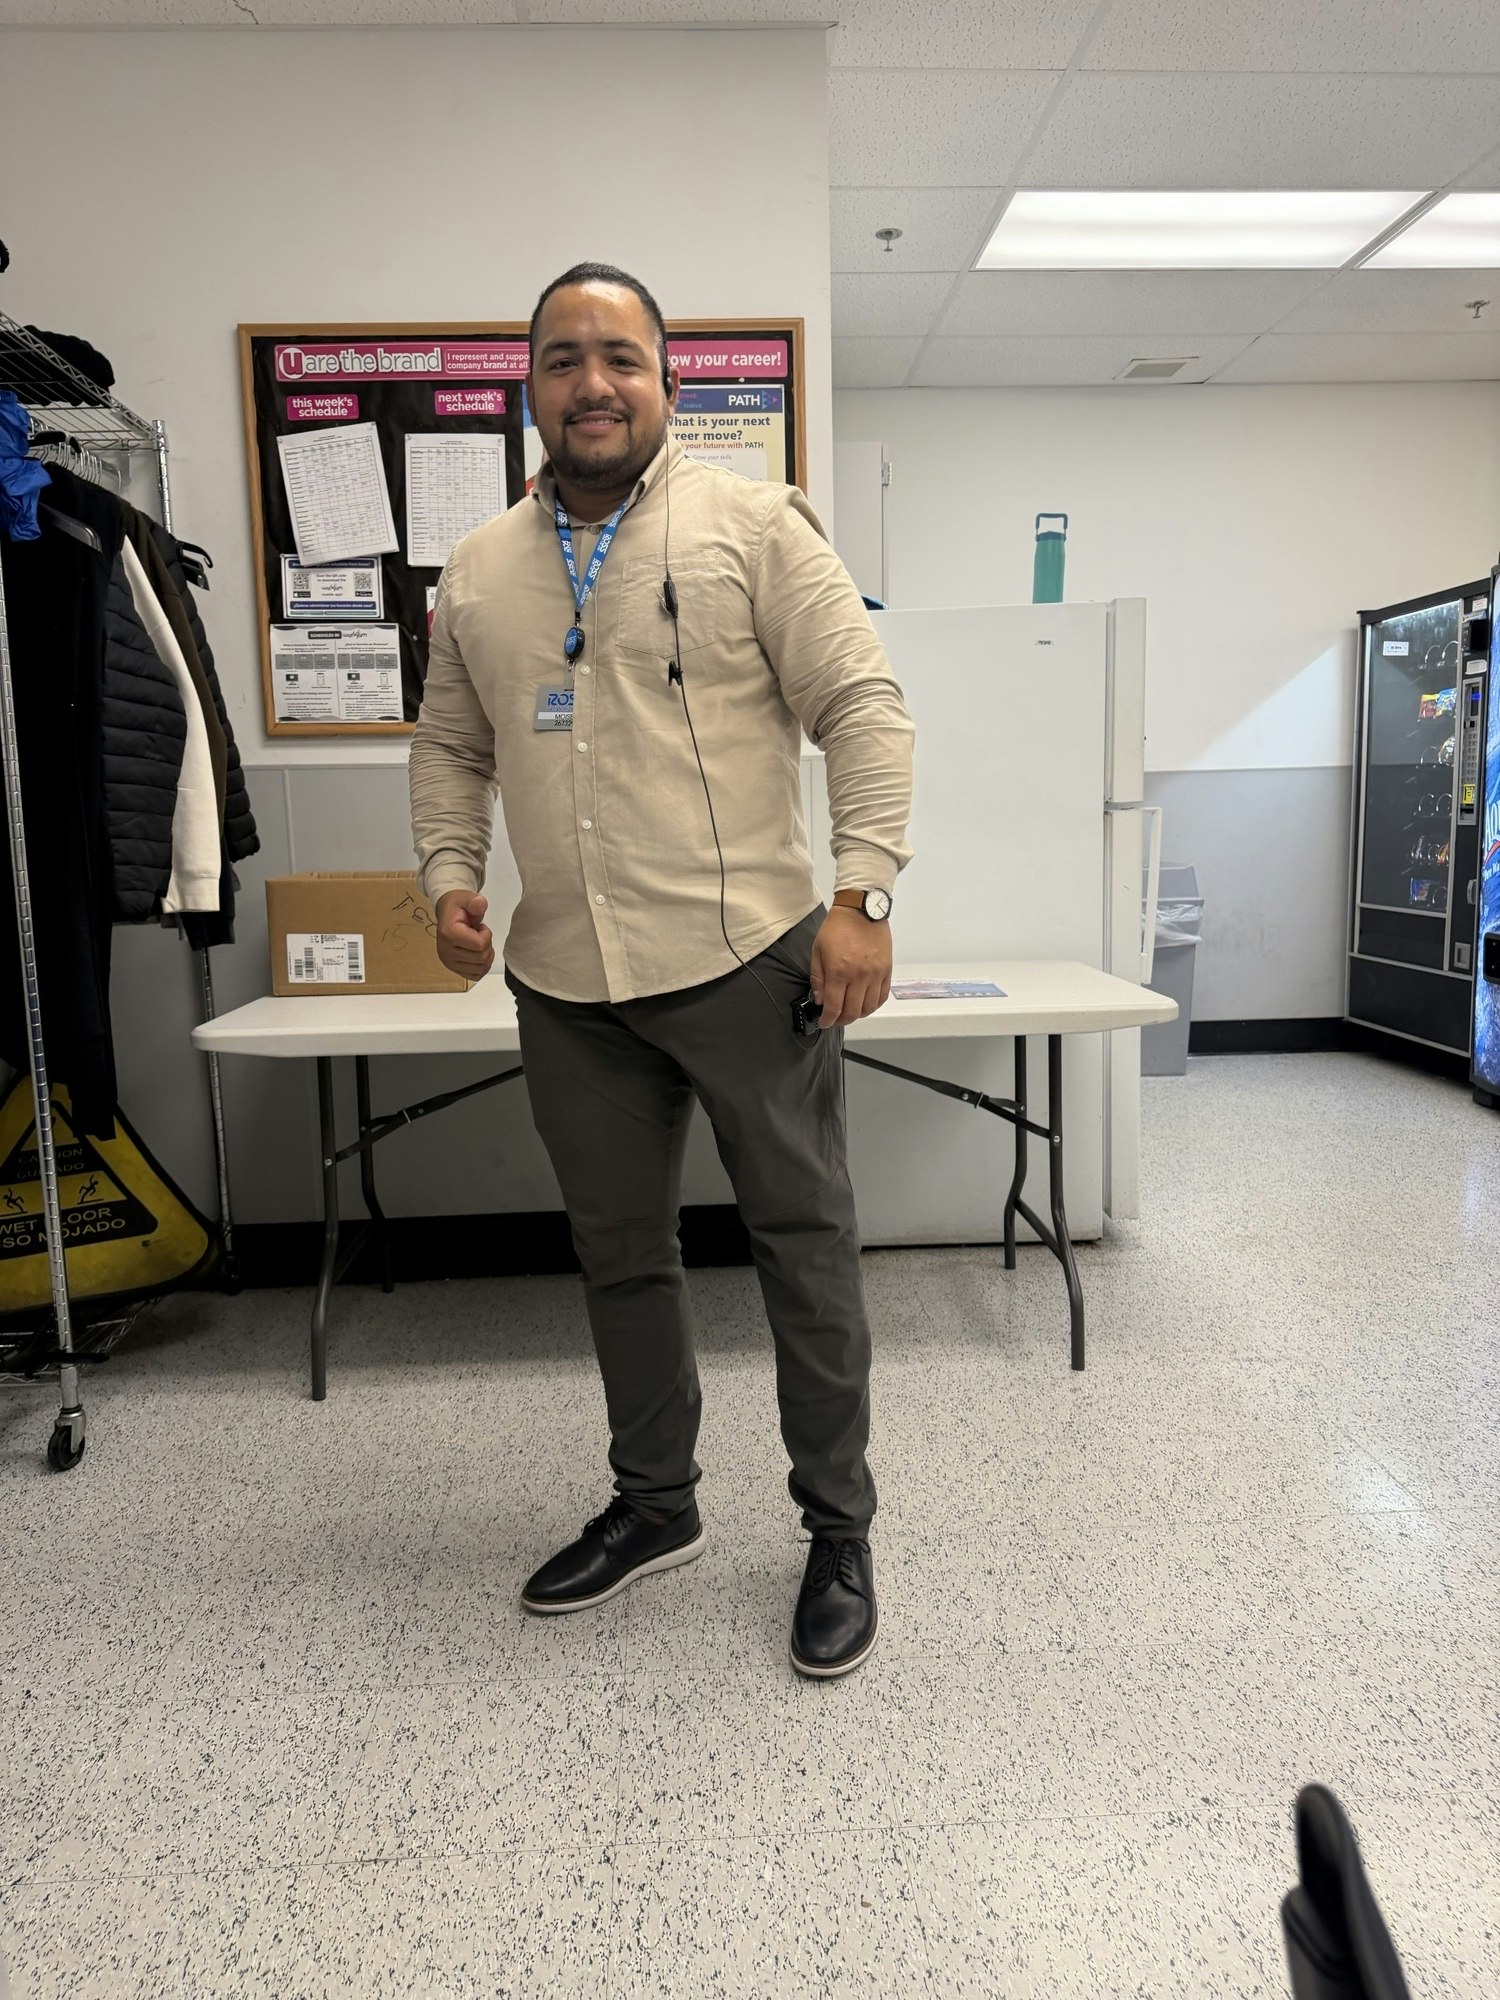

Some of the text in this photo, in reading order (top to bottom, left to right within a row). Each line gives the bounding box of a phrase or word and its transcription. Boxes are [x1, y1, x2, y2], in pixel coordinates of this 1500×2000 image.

[452, 353, 488, 362] represent
[490, 352, 505, 361] and
[505, 354, 530, 362] suppo
[695, 354, 729, 369] your
[731, 351, 782, 366] career!
[447, 361, 482, 370] company
[483, 361, 508, 369] brand
[518, 361, 529, 369] all
[292, 396, 354, 408] this week's
[438, 391, 503, 403] next week's
[728, 394, 761, 406] PATH
[298, 407, 349, 418] schedule
[446, 401, 495, 412] schedule
[698, 416, 708, 427] is
[711, 417, 740, 429] your
[743, 416, 771, 426] next
[673, 430, 743, 441] reer move?
[685, 443, 701, 451] your
[744, 441, 764, 449] PATH
[600, 533, 613, 554] ROSS
[589, 557, 602, 580] ROSS
[18, 1148, 83, 1164] CAION
[61, 1207, 112, 1225] OOR
